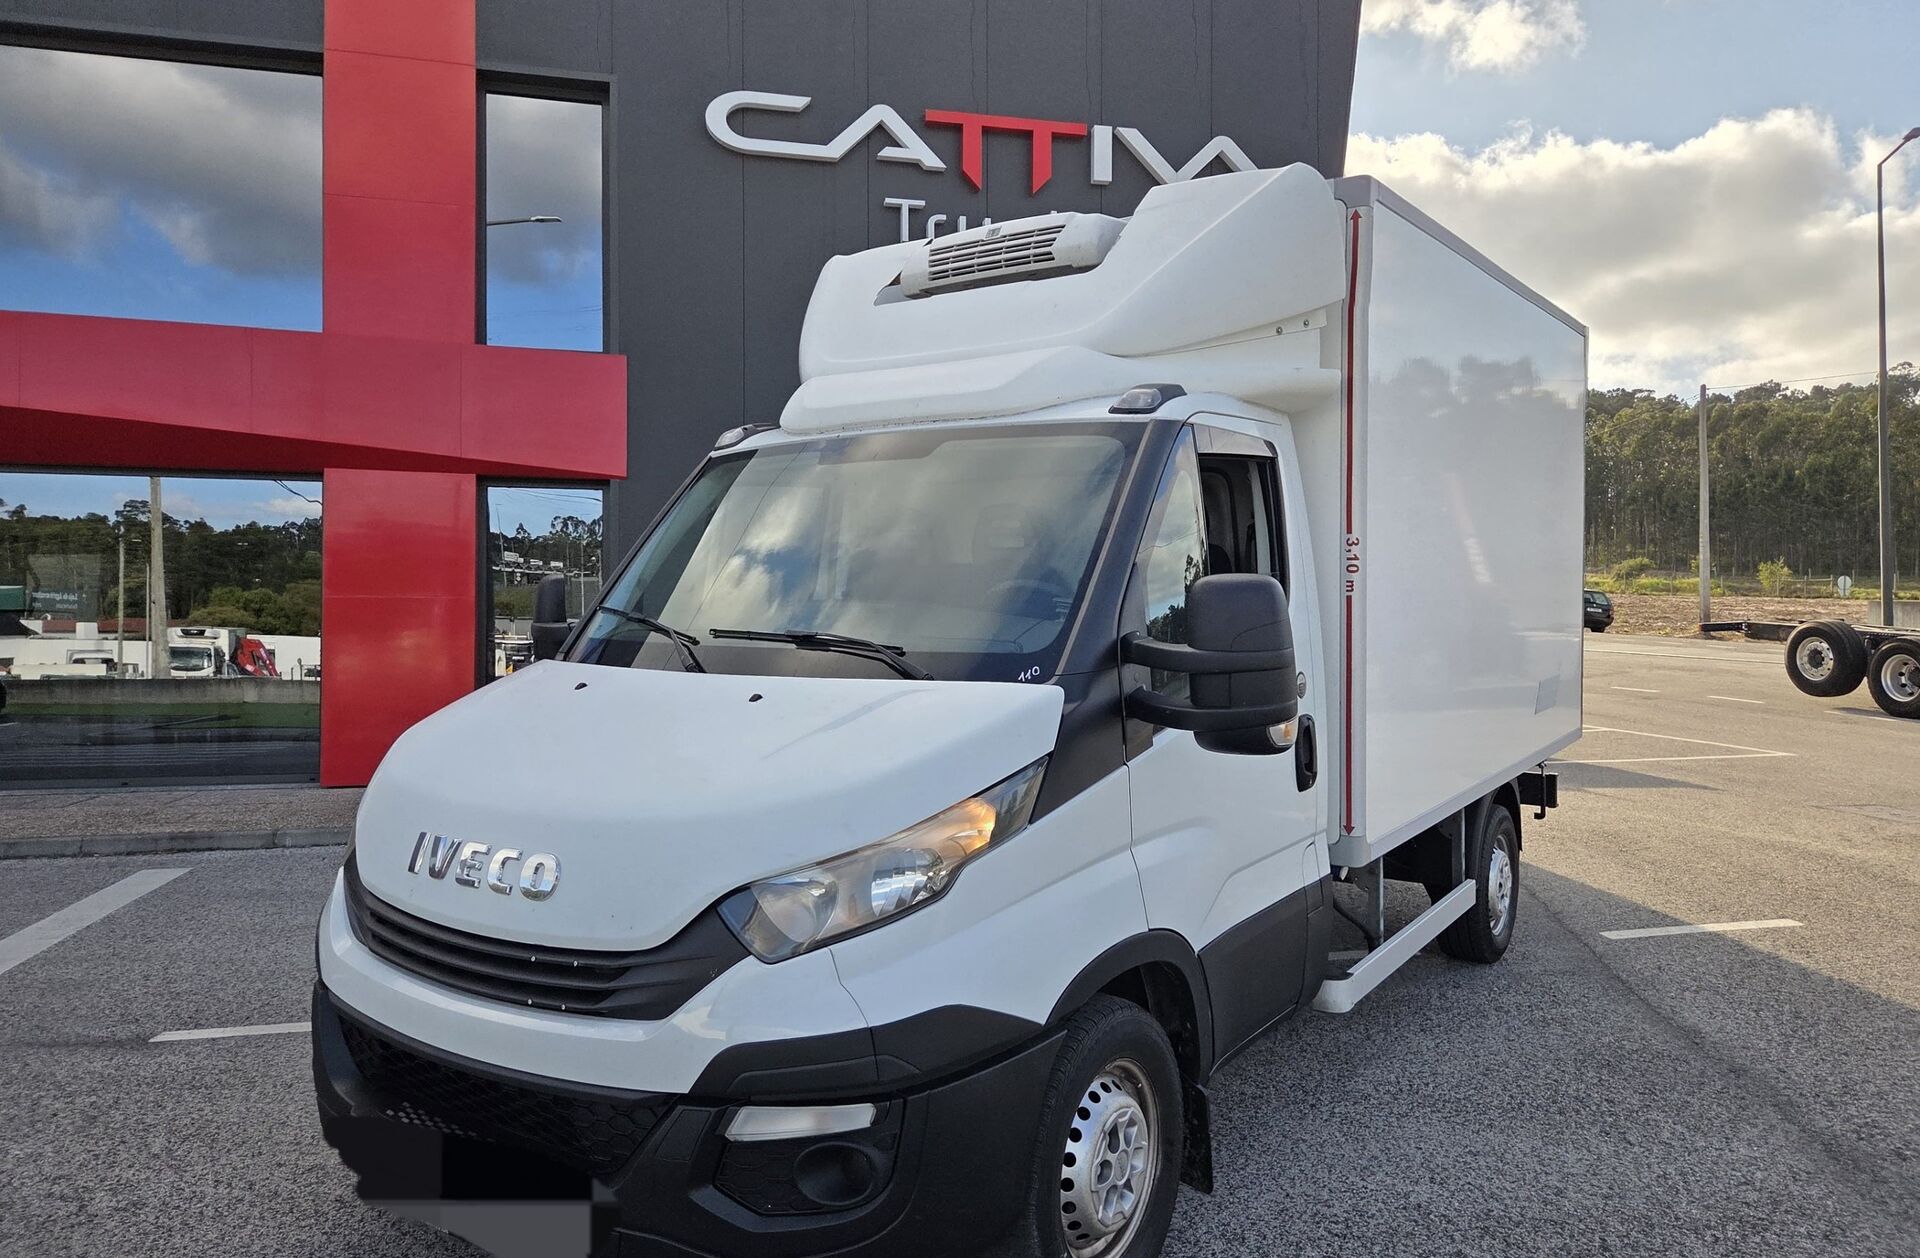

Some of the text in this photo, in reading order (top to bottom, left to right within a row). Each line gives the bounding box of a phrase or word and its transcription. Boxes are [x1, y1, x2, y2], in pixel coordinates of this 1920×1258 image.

[1345, 537, 1360, 593] 3,10 m
[1018, 665, 1040, 682] 110
[408, 832, 561, 902] IVECO
